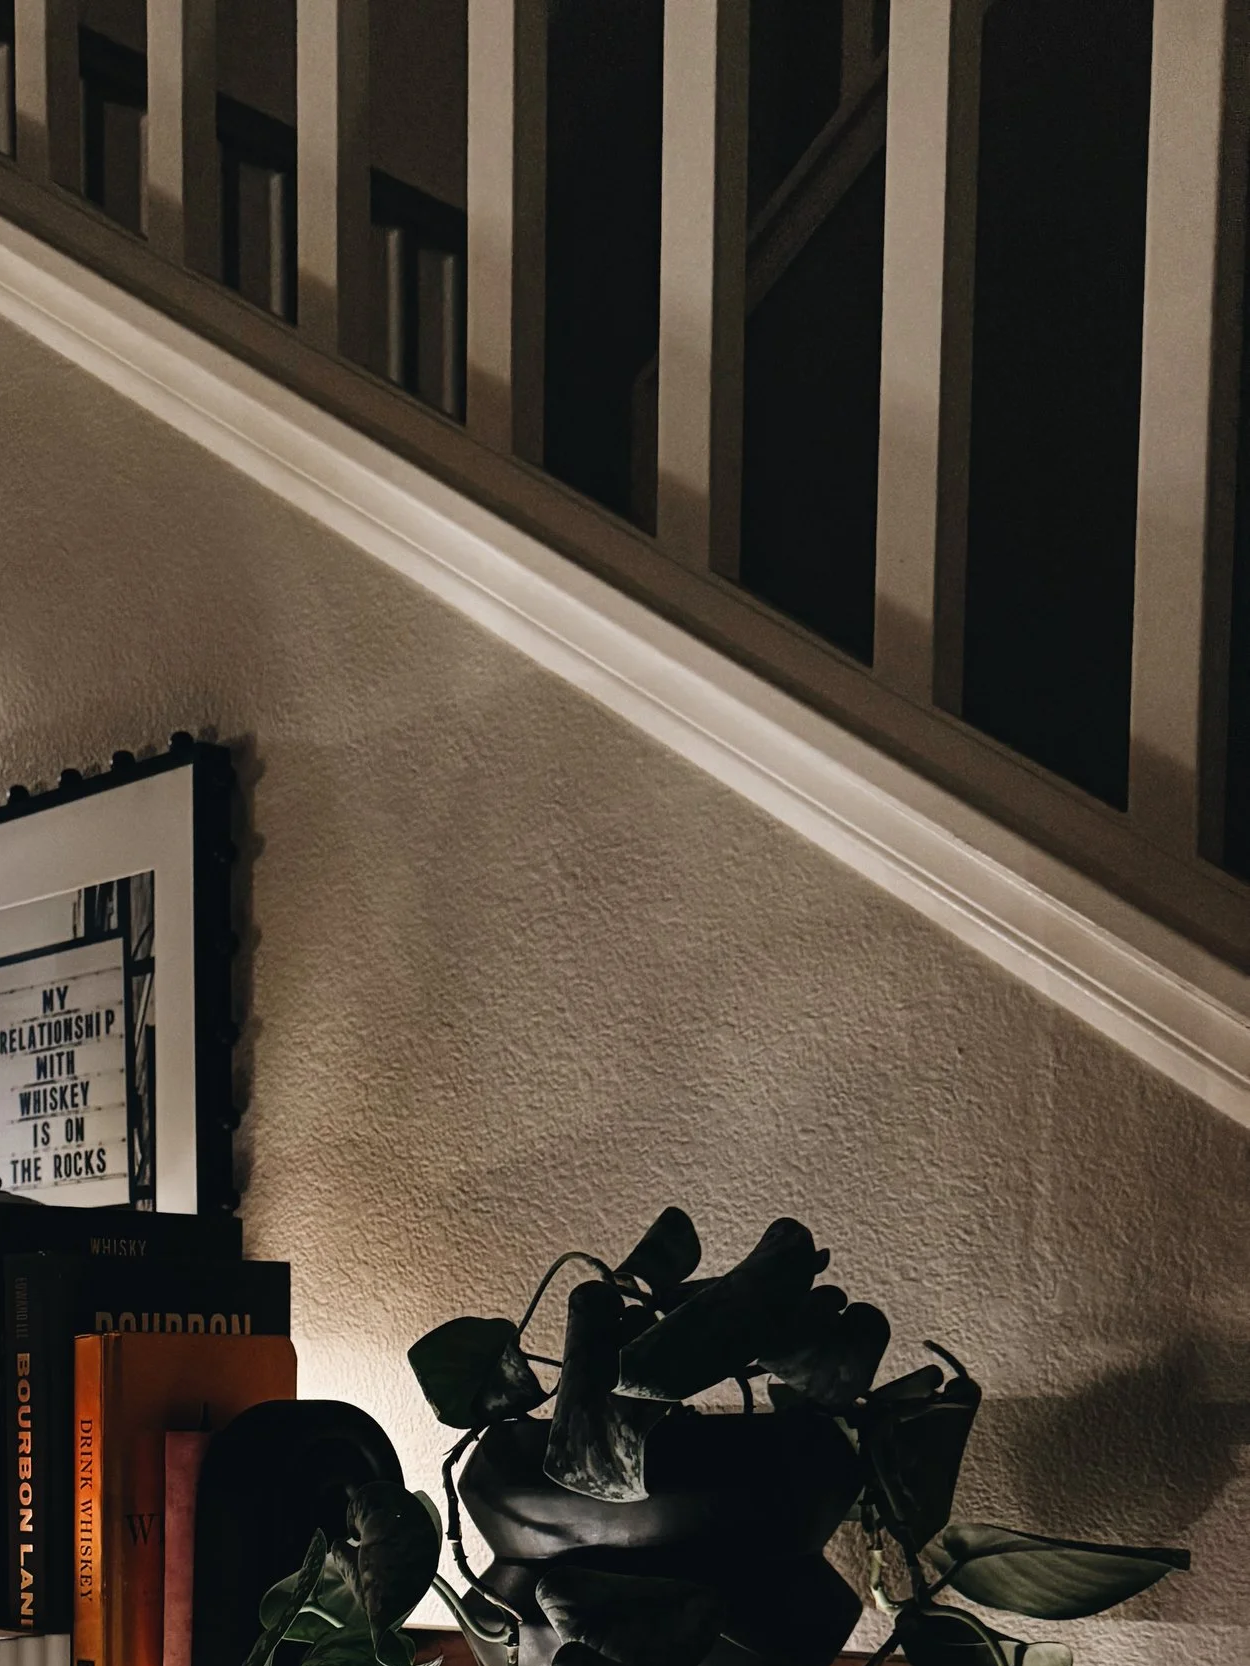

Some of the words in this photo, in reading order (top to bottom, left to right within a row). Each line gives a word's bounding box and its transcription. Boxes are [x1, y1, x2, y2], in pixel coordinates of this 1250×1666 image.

[42, 985, 69, 1014] MY
[36, 1050, 75, 1081] WITH
[18, 1081, 90, 1116] WHISKEY
[33, 1122, 51, 1148] IS
[65, 1117, 85, 1143] ON
[10, 1157, 42, 1185] THE
[53, 1148, 107, 1179] ROCKS
[90, 1237, 147, 1257] WHISKY
[16, 1352, 34, 1533] BOURBON
[79, 1419, 93, 1490] DRINK
[79, 1499, 93, 1602] WHISKEY
